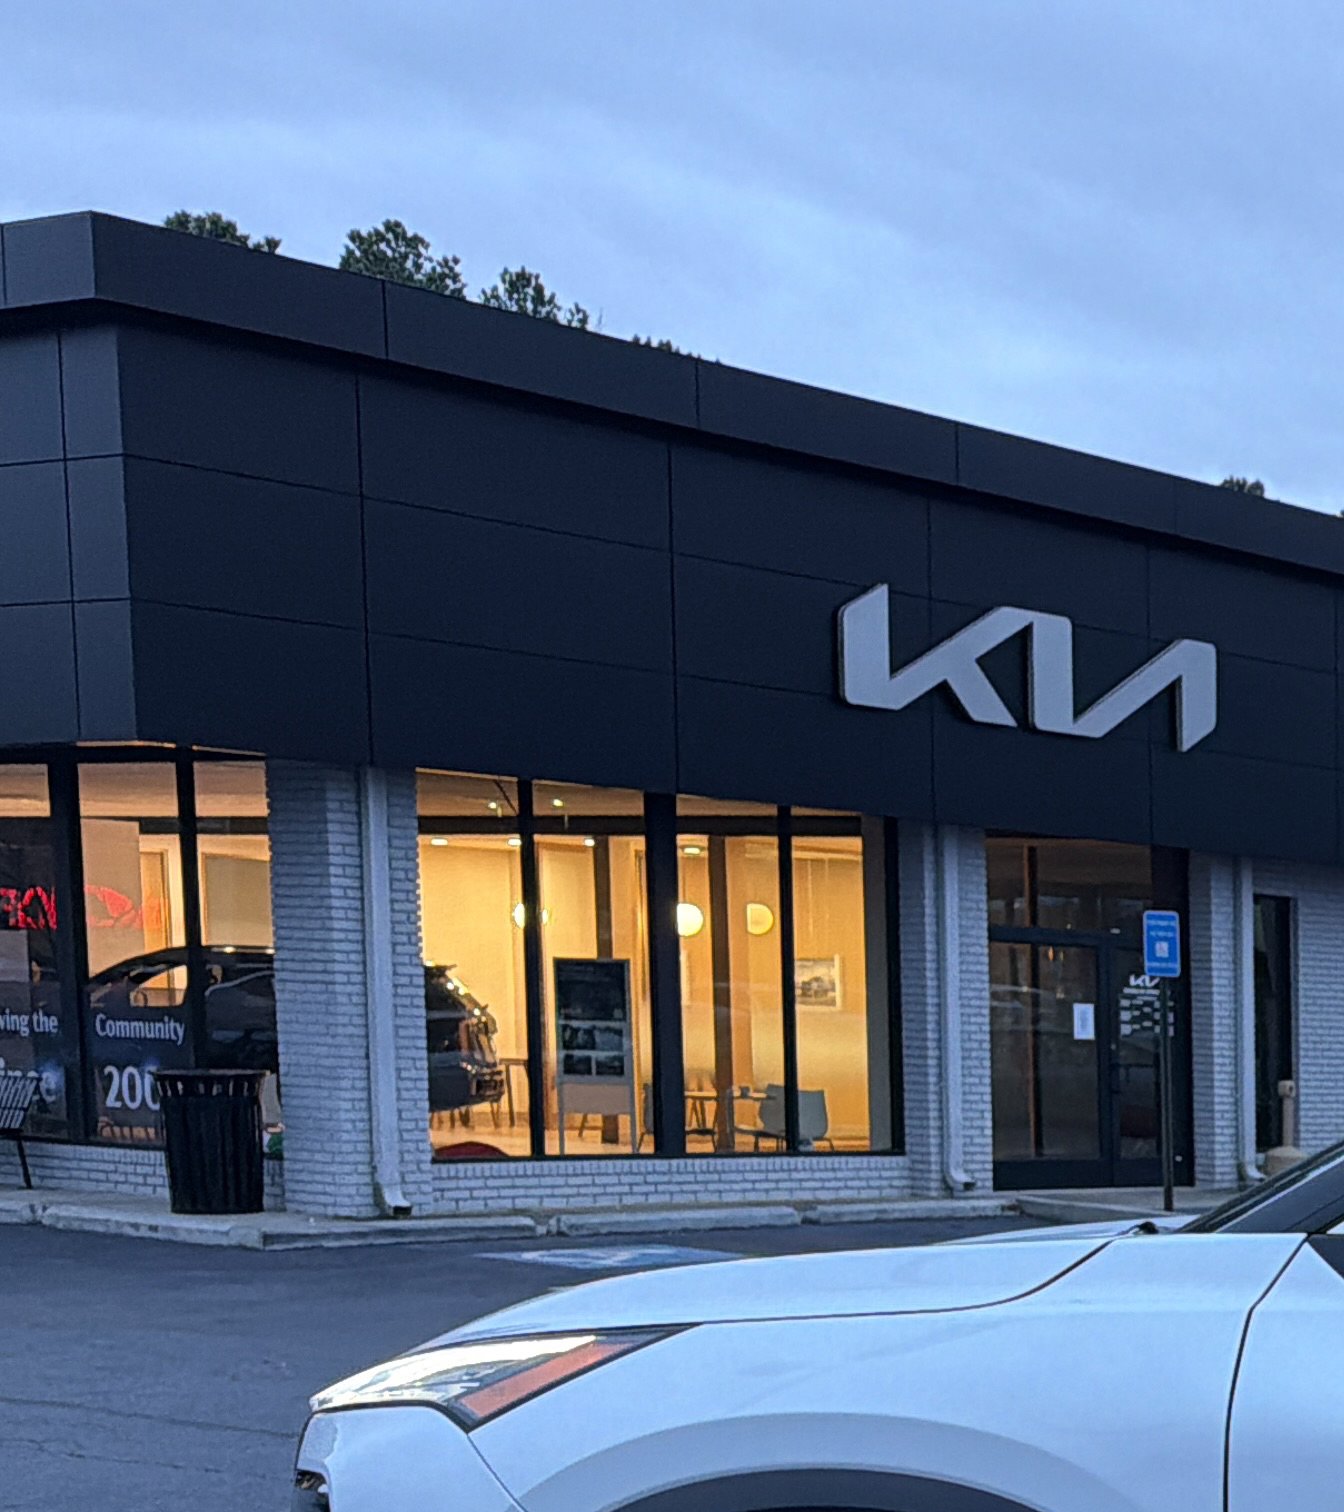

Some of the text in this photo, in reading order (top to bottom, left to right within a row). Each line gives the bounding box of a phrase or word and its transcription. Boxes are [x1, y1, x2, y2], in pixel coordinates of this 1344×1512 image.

[837, 582, 1218, 753] KIA
[32, 1008, 58, 1032] the
[96, 1013, 185, 1046] Community
